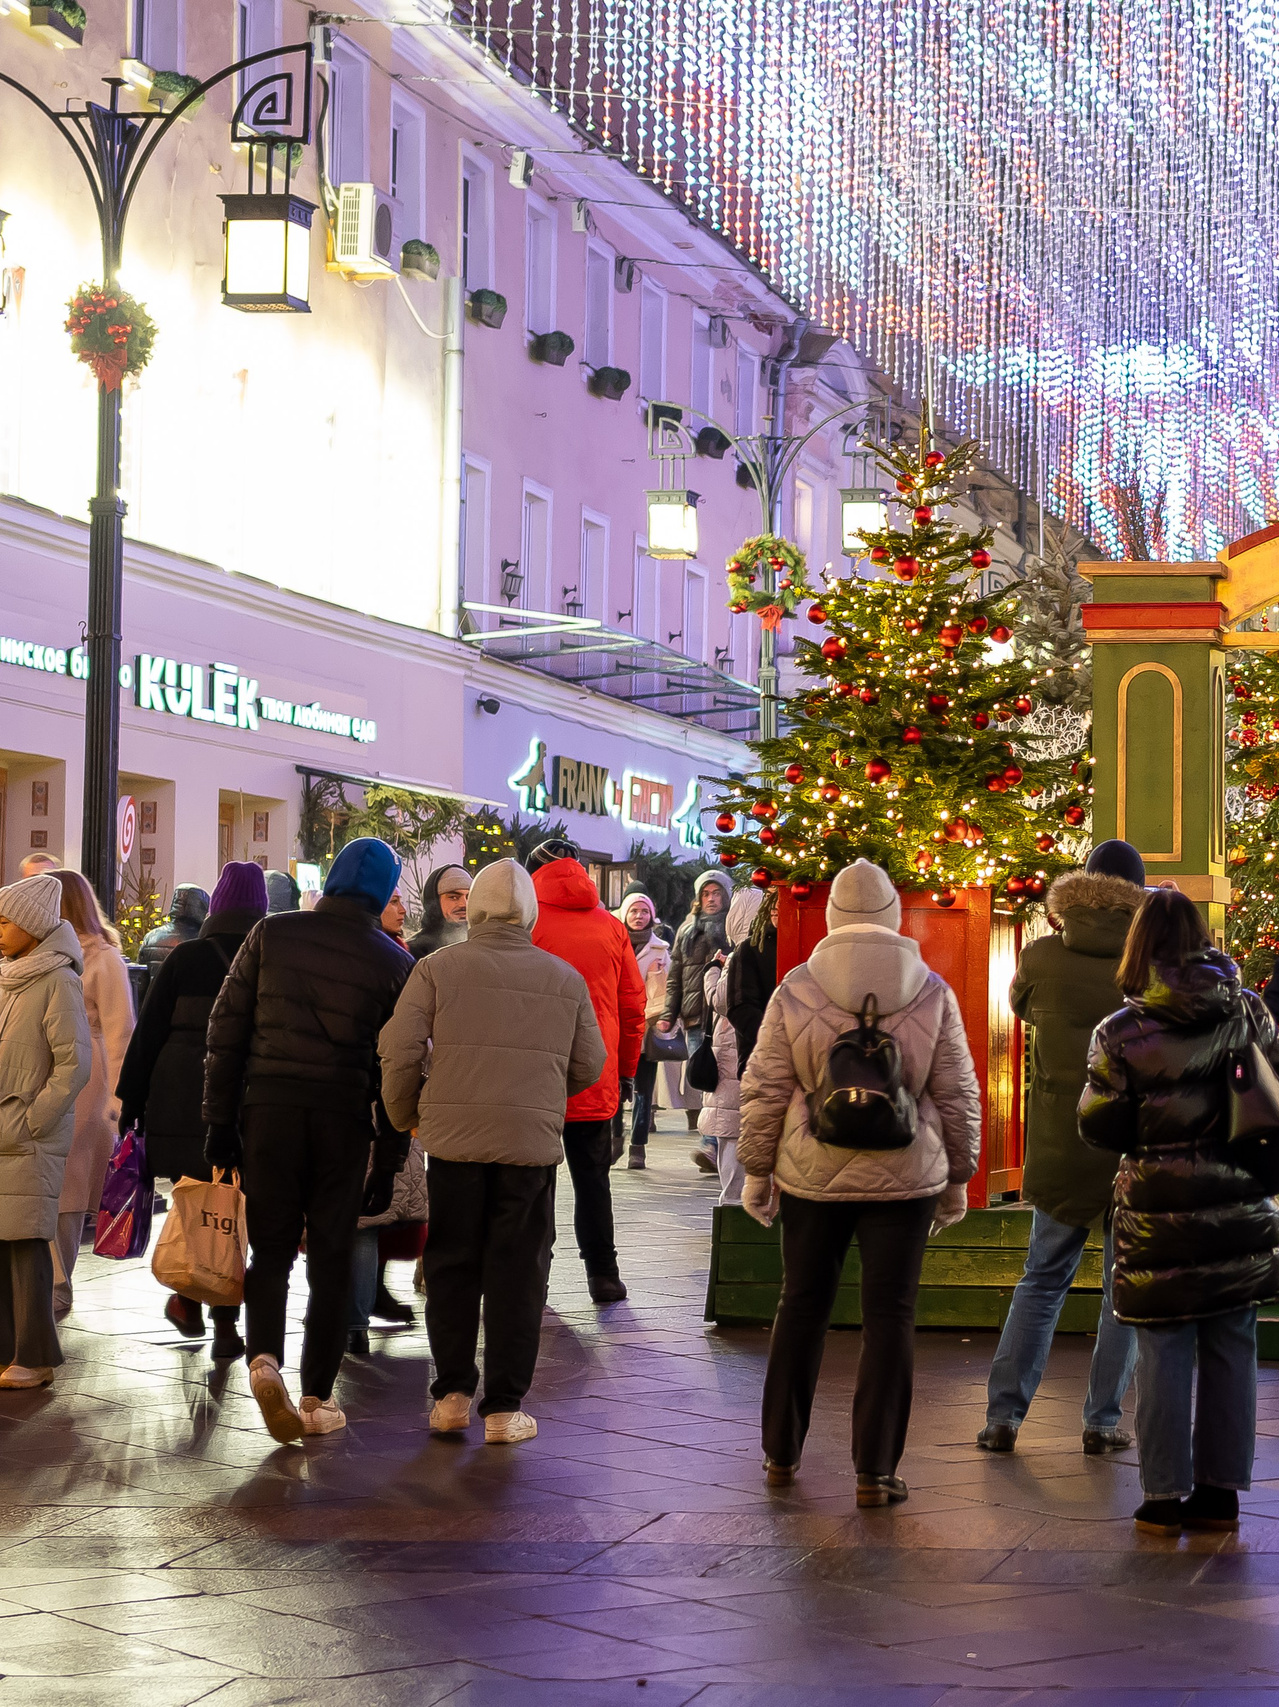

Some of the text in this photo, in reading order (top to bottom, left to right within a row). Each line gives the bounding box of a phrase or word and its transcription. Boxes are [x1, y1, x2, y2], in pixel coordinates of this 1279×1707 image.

[260, 696, 377, 743] твоя любимая еда
[556, 756, 609, 815] FRANK
